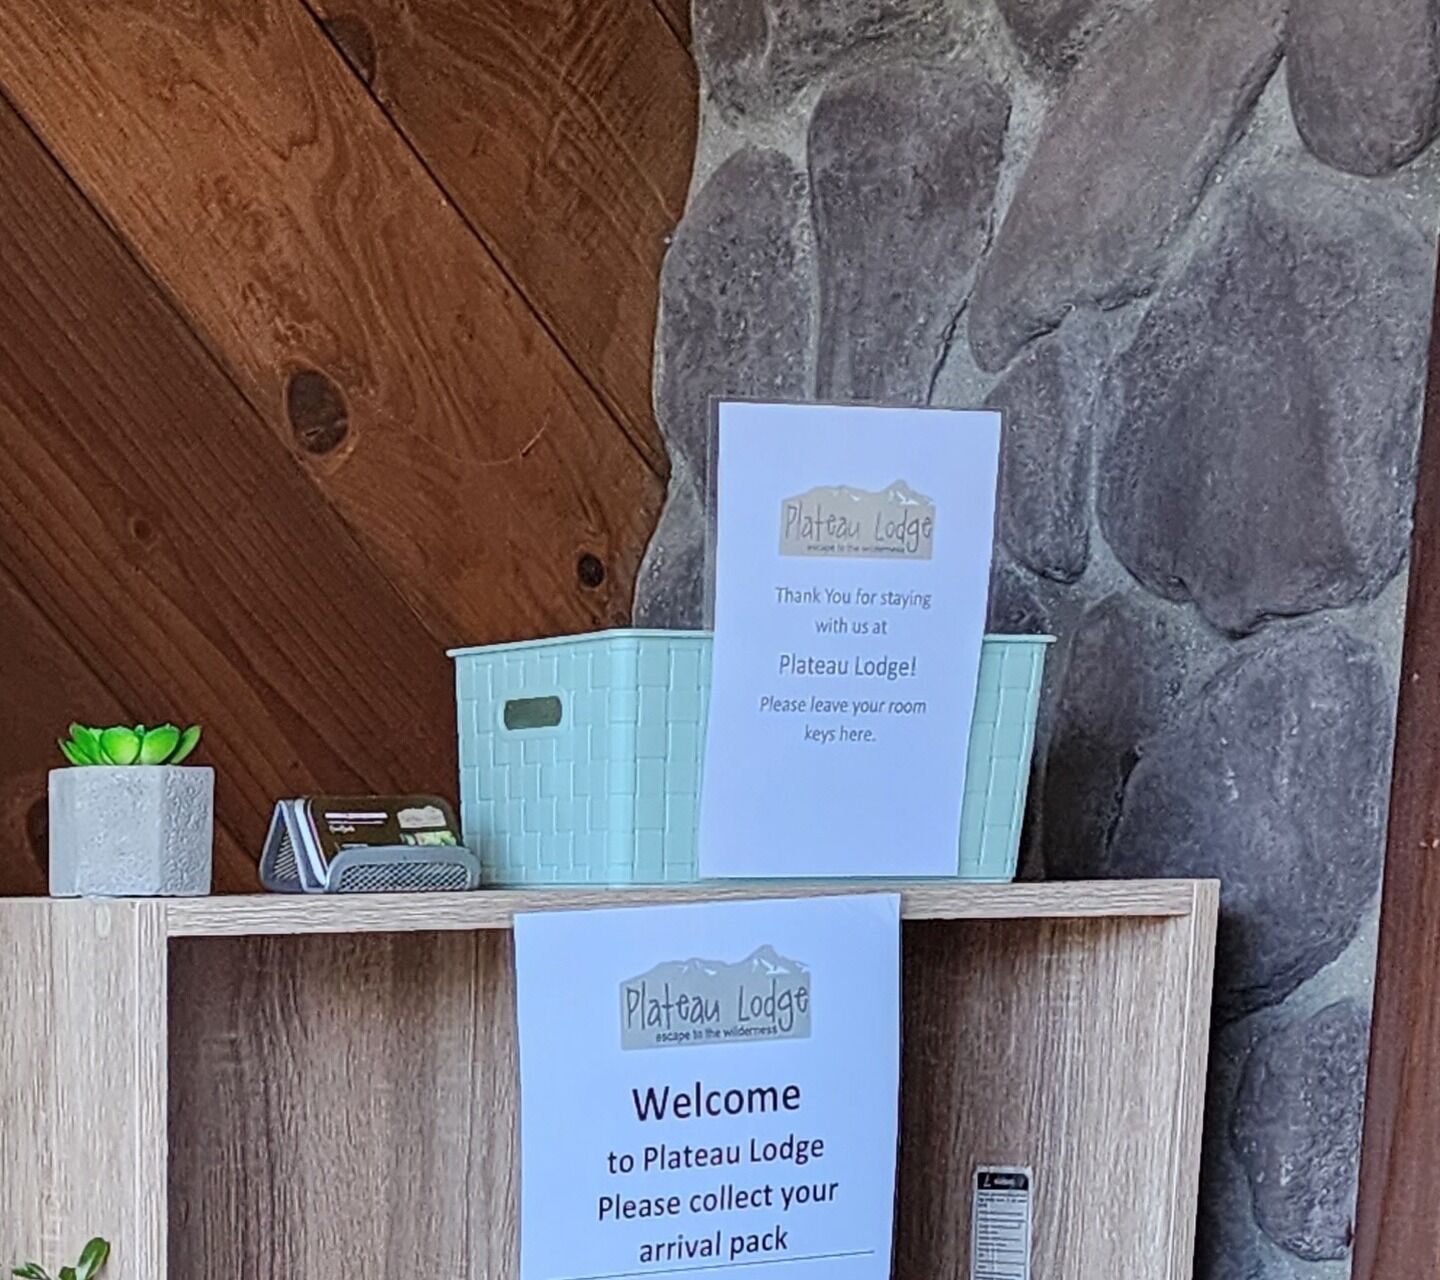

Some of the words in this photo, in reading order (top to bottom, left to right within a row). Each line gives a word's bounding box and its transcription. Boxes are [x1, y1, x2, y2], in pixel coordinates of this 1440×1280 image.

[785, 501, 860, 542] Plateau
[874, 508, 932, 553] Lodge
[776, 587, 821, 604] Thank
[825, 588, 851, 604] You
[856, 588, 878, 605] for
[880, 590, 932, 609] staying
[815, 617, 848, 634] with
[852, 621, 868, 634] us
[872, 620, 888, 635] at
[779, 653, 849, 675] Plateau
[855, 656, 917, 681] Lodge!
[759, 695, 806, 712] Please
[810, 696, 848, 713] leave
[852, 701, 885, 716] your
[888, 701, 927, 714] room
[804, 724, 835, 744] keys
[839, 725, 876, 742] here.
[626, 980, 720, 1030] Plateau
[738, 978, 809, 1032] Lodge
[655, 1031, 691, 1043] escape
[693, 1030, 702, 1040] to
[705, 1028, 721, 1038] the
[723, 1025, 778, 1036] wilderness
[632, 1081, 801, 1122] Welcome
[607, 1151, 634, 1174] to
[644, 1144, 740, 1172] Plateau
[750, 1133, 825, 1165] Lodge
[598, 1194, 681, 1221] Please
[689, 1184, 773, 1213] collect
[781, 1182, 839, 1211] your
[640, 1230, 721, 1263] arrival
[730, 1225, 788, 1260] pack
